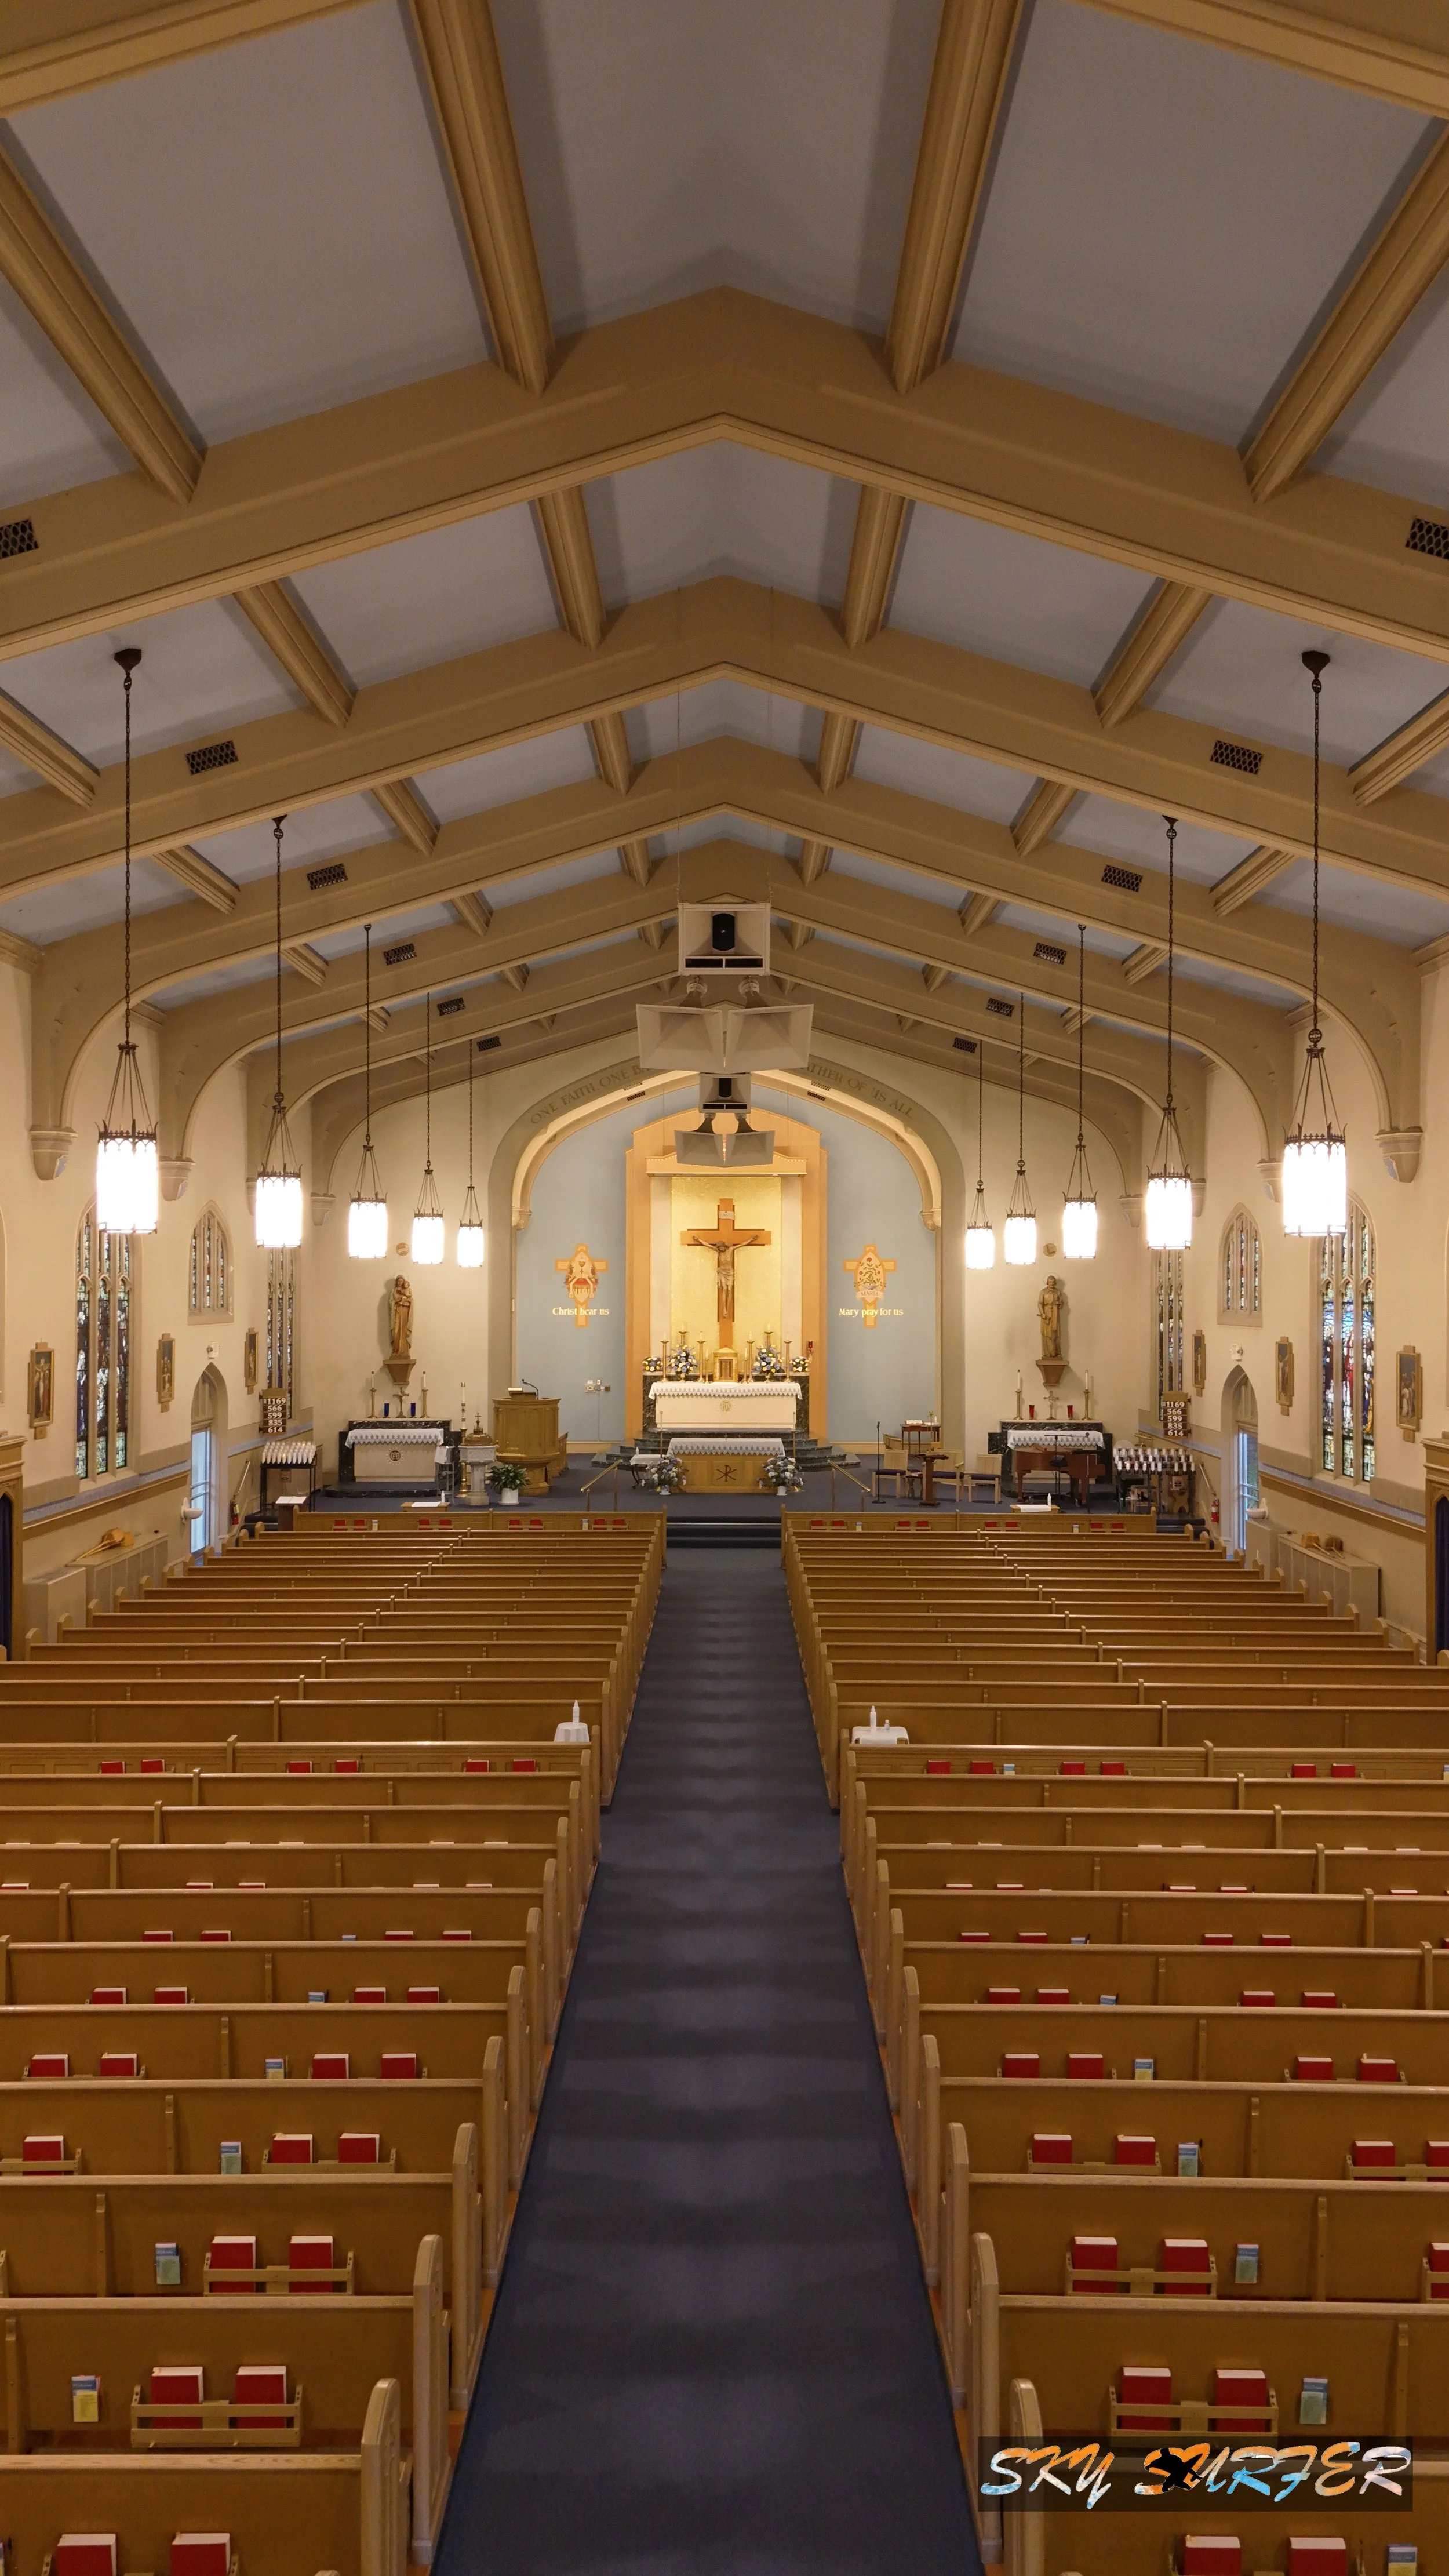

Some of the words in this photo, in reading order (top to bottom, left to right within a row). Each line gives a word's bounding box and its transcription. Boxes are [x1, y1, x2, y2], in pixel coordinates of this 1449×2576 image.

[530, 1103, 559, 1124] ONE
[599, 1069, 631, 1087] ONE
[848, 1078, 868, 1091] OF
[889, 1099, 913, 1118] ALL
[552, 1307, 577, 1315] Christ
[580, 1307, 597, 1315] hear
[839, 1308, 859, 1318] Mary
[861, 1309, 878, 1318] pray
